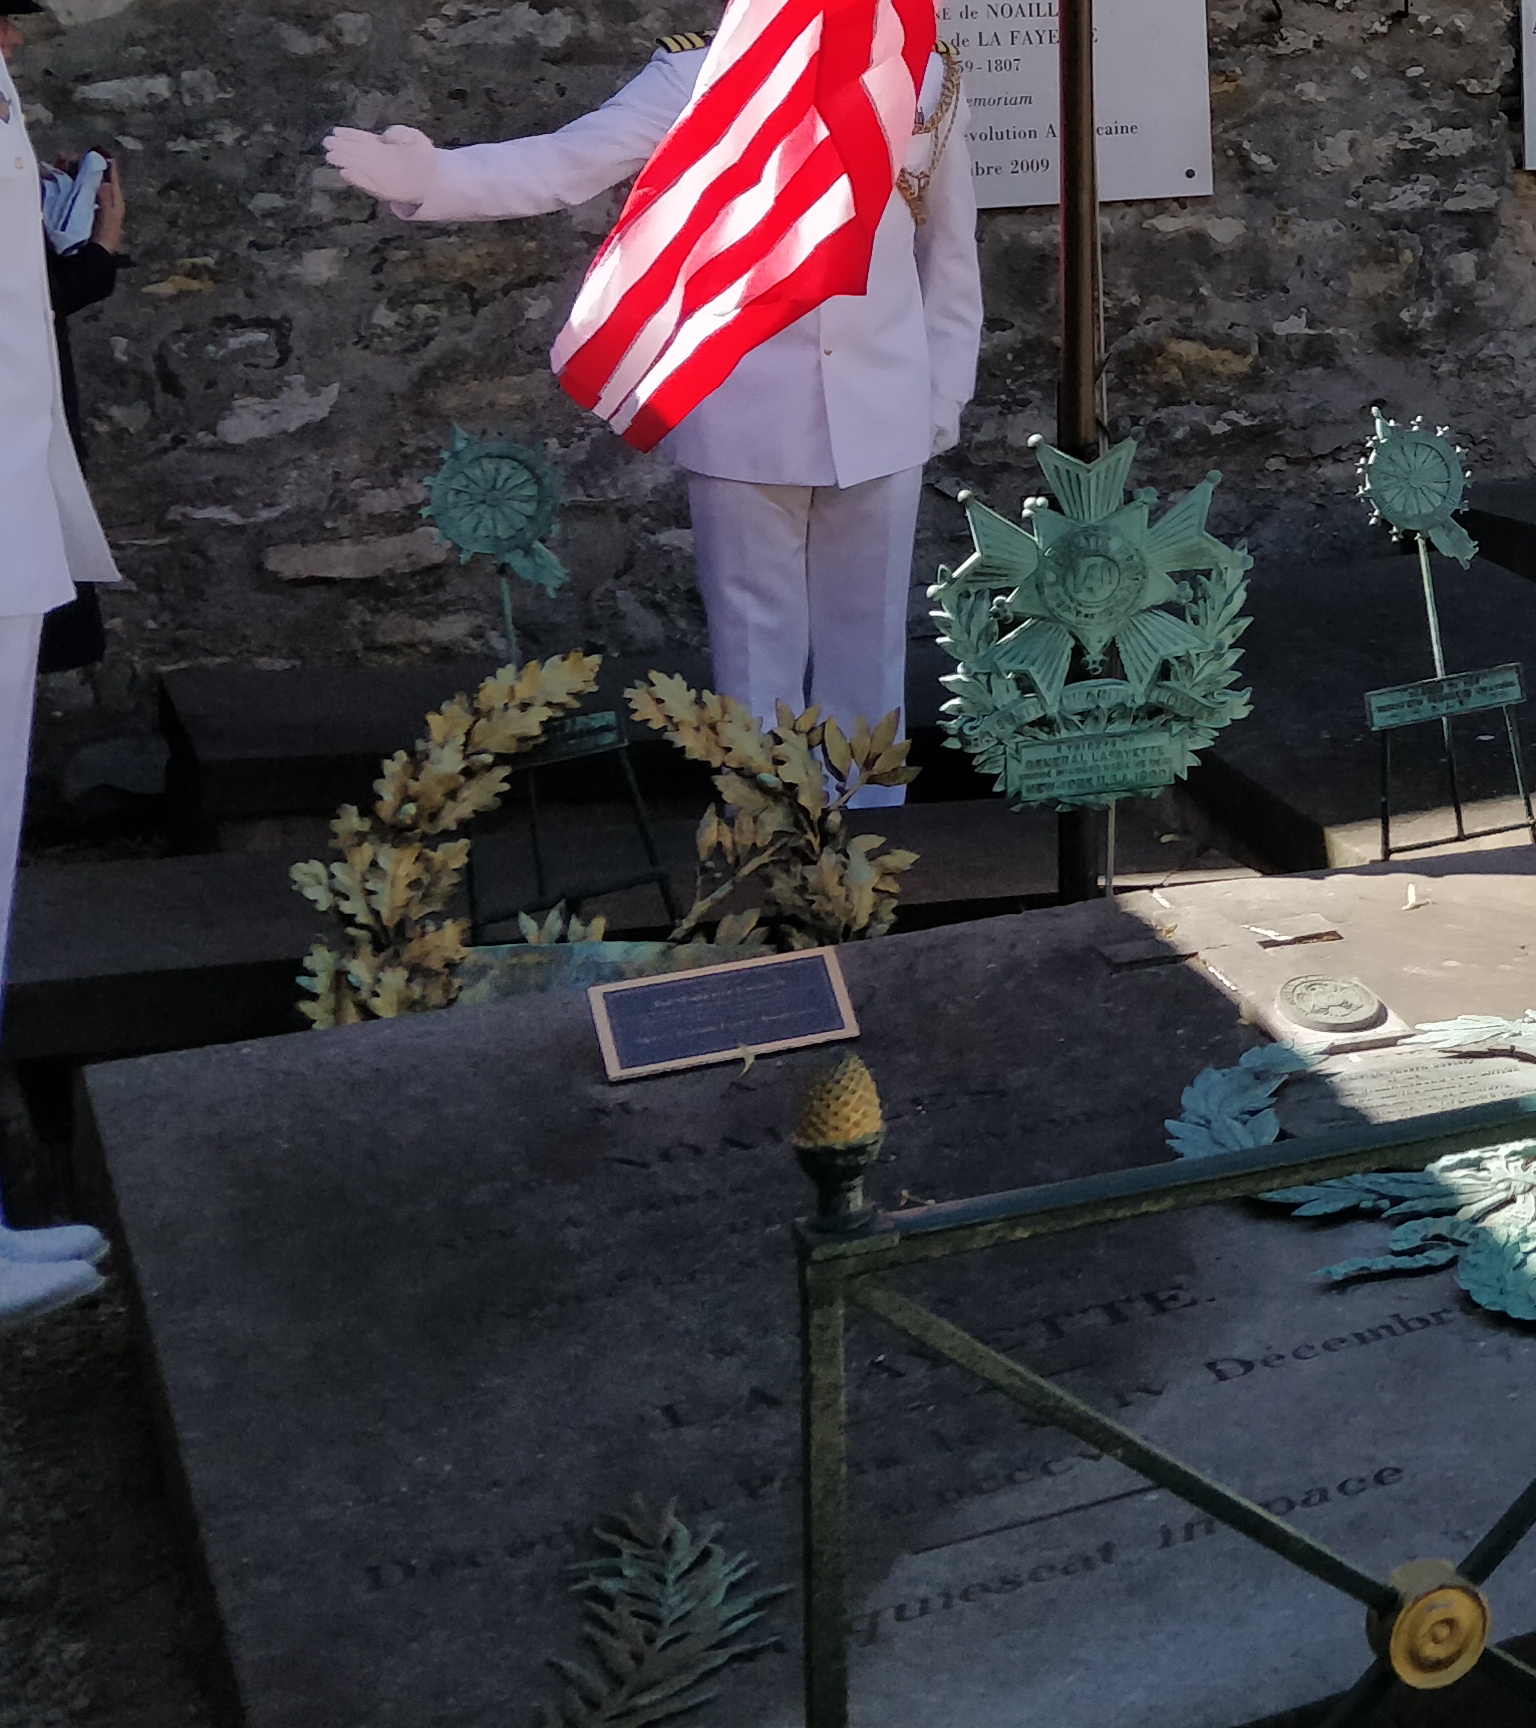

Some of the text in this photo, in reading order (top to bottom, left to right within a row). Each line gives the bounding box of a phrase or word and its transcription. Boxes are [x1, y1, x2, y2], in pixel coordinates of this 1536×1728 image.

[959, 5, 978, 20] de
[987, 2, 1059, 19] NOAILL
[951, 33, 970, 47] de
[978, 31, 1001, 47] LA
[1010, 158, 1050, 175] 2009
